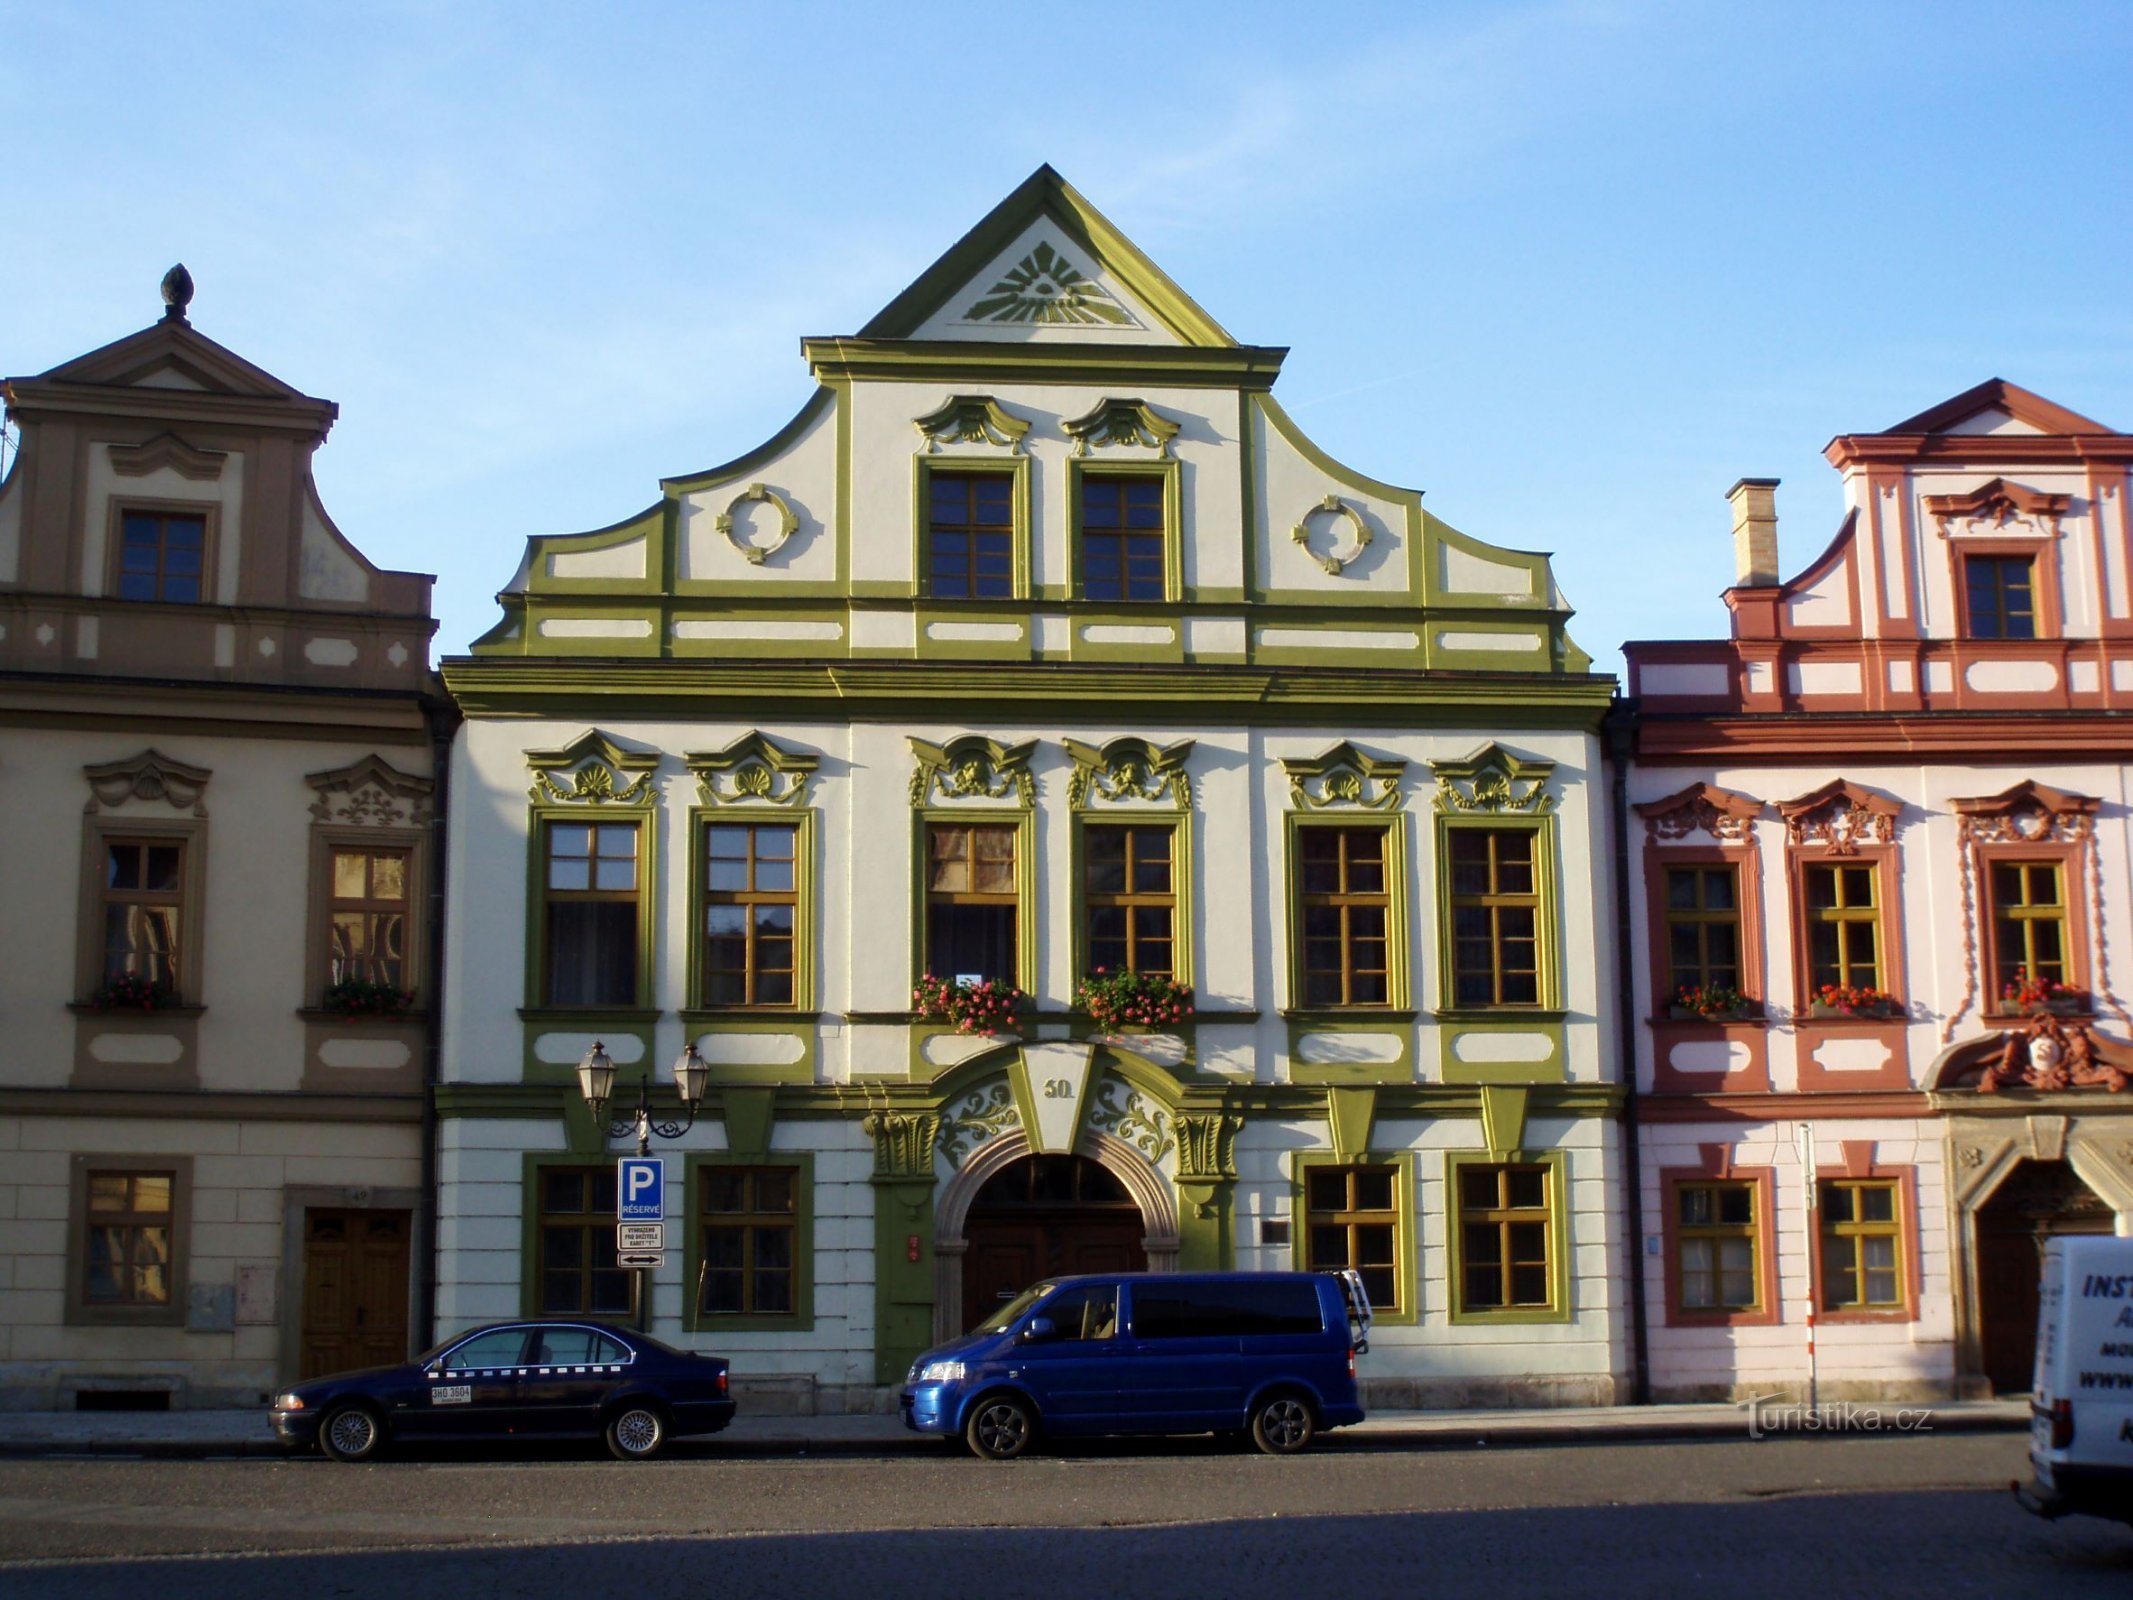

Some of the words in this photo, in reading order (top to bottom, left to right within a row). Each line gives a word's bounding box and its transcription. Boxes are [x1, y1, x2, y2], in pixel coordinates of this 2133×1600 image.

[629, 1166, 654, 1201] P
[623, 1204, 660, 1214] RÉSERVÉ
[450, 1386, 469, 1398] 3604
